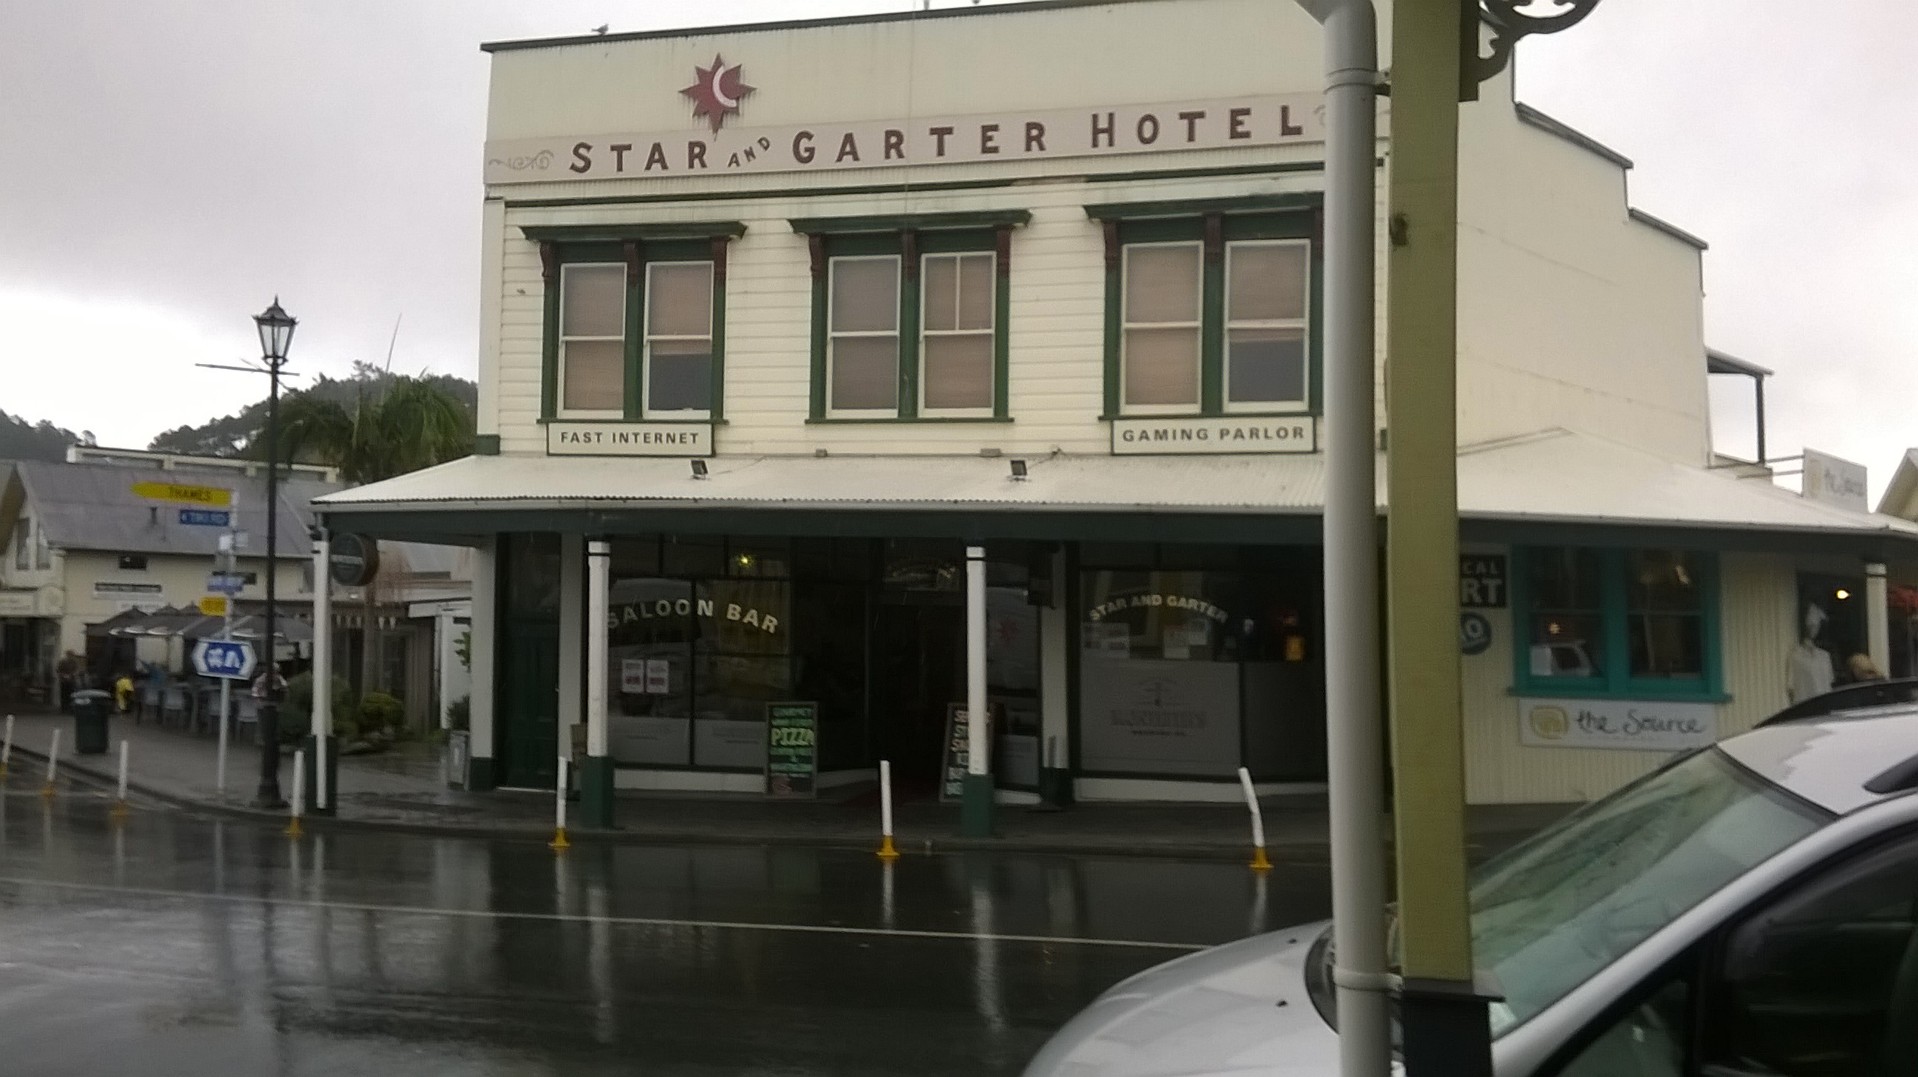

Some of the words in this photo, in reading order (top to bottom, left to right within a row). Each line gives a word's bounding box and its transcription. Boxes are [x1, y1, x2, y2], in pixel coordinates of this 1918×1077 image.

[569, 141, 708, 174] STAR
[727, 136, 771, 168] AND
[792, 121, 1046, 164] GARTER
[1091, 104, 1303, 148] HOTEL
[560, 431, 603, 444] FAST
[612, 431, 699, 444] INTERNET
[1122, 428, 1209, 442] GAMING
[1219, 426, 1305, 440] PARLOR
[168, 486, 212, 502] THAMES
[1461, 560, 1499, 575] CAL
[1461, 578, 1502, 603] RT
[608, 599, 714, 629] SALOON
[726, 603, 778, 633] BAR
[1090, 598, 1127, 620] STAR
[1132, 594, 1162, 607] AND
[1166, 595, 1228, 623] GARTER
[1576, 709, 1618, 735] the
[1622, 709, 1706, 736] Source
[771, 727, 815, 746] PIZZA
